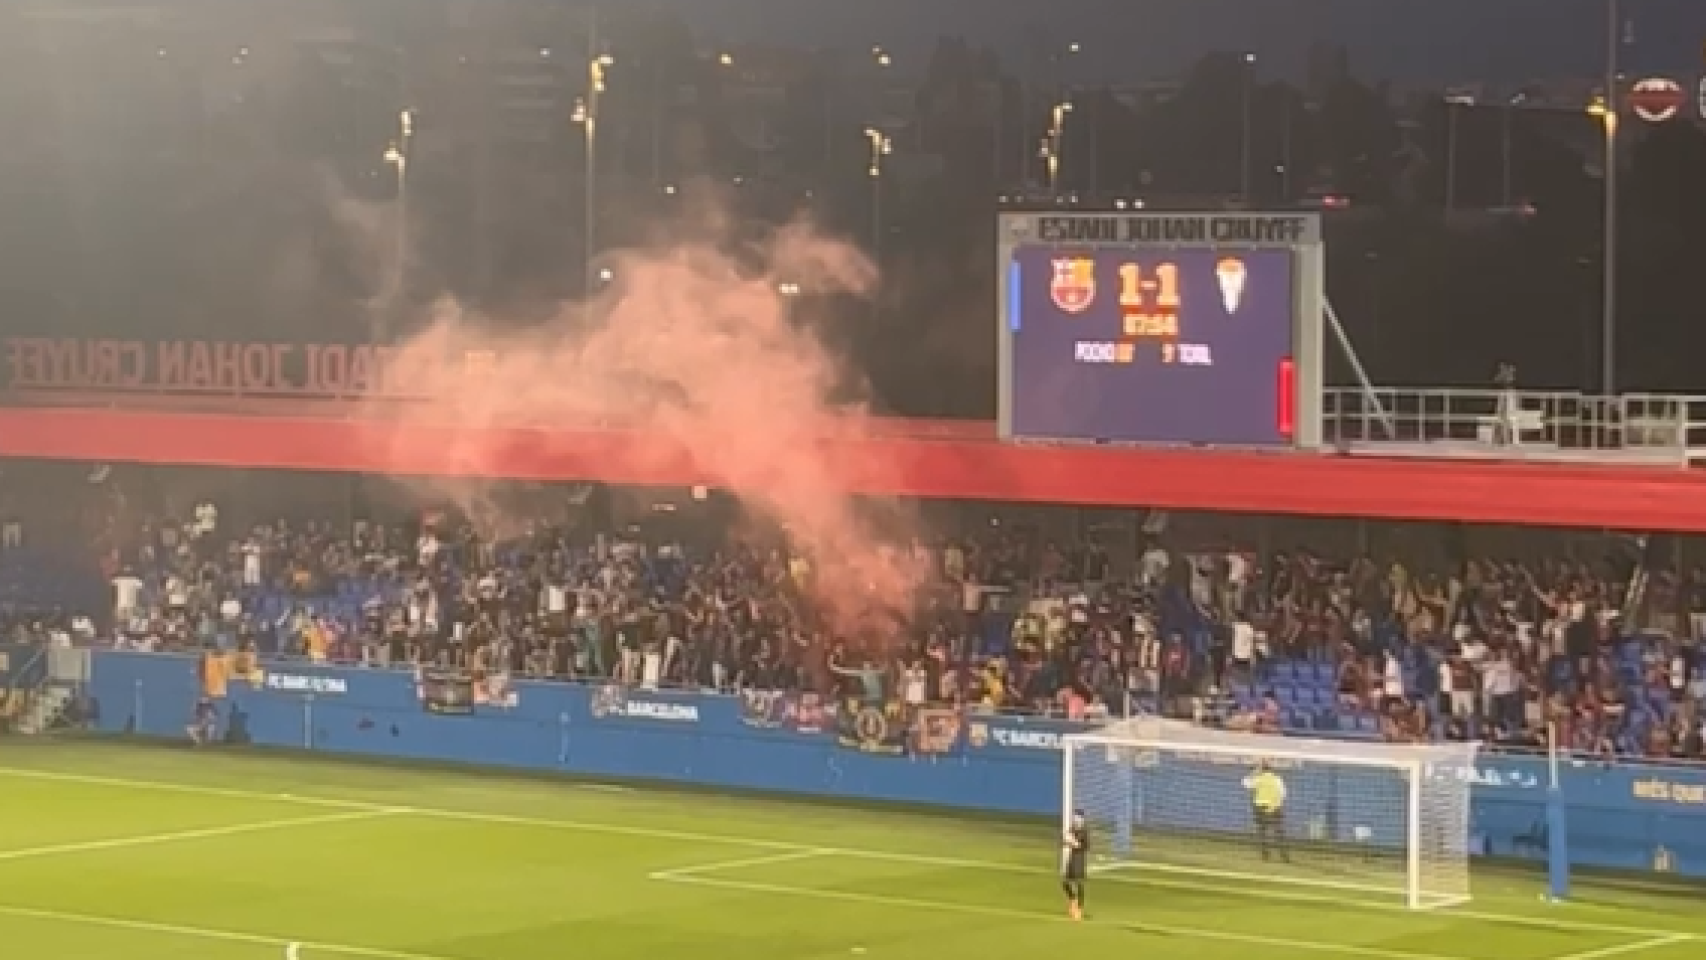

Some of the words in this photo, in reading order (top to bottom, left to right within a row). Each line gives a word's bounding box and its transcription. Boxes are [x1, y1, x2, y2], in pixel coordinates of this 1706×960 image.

[1126, 217, 1205, 240] JOHAN
[1211, 217, 1307, 241] CRUYFF
[1118, 262, 1181, 307] 1-1
